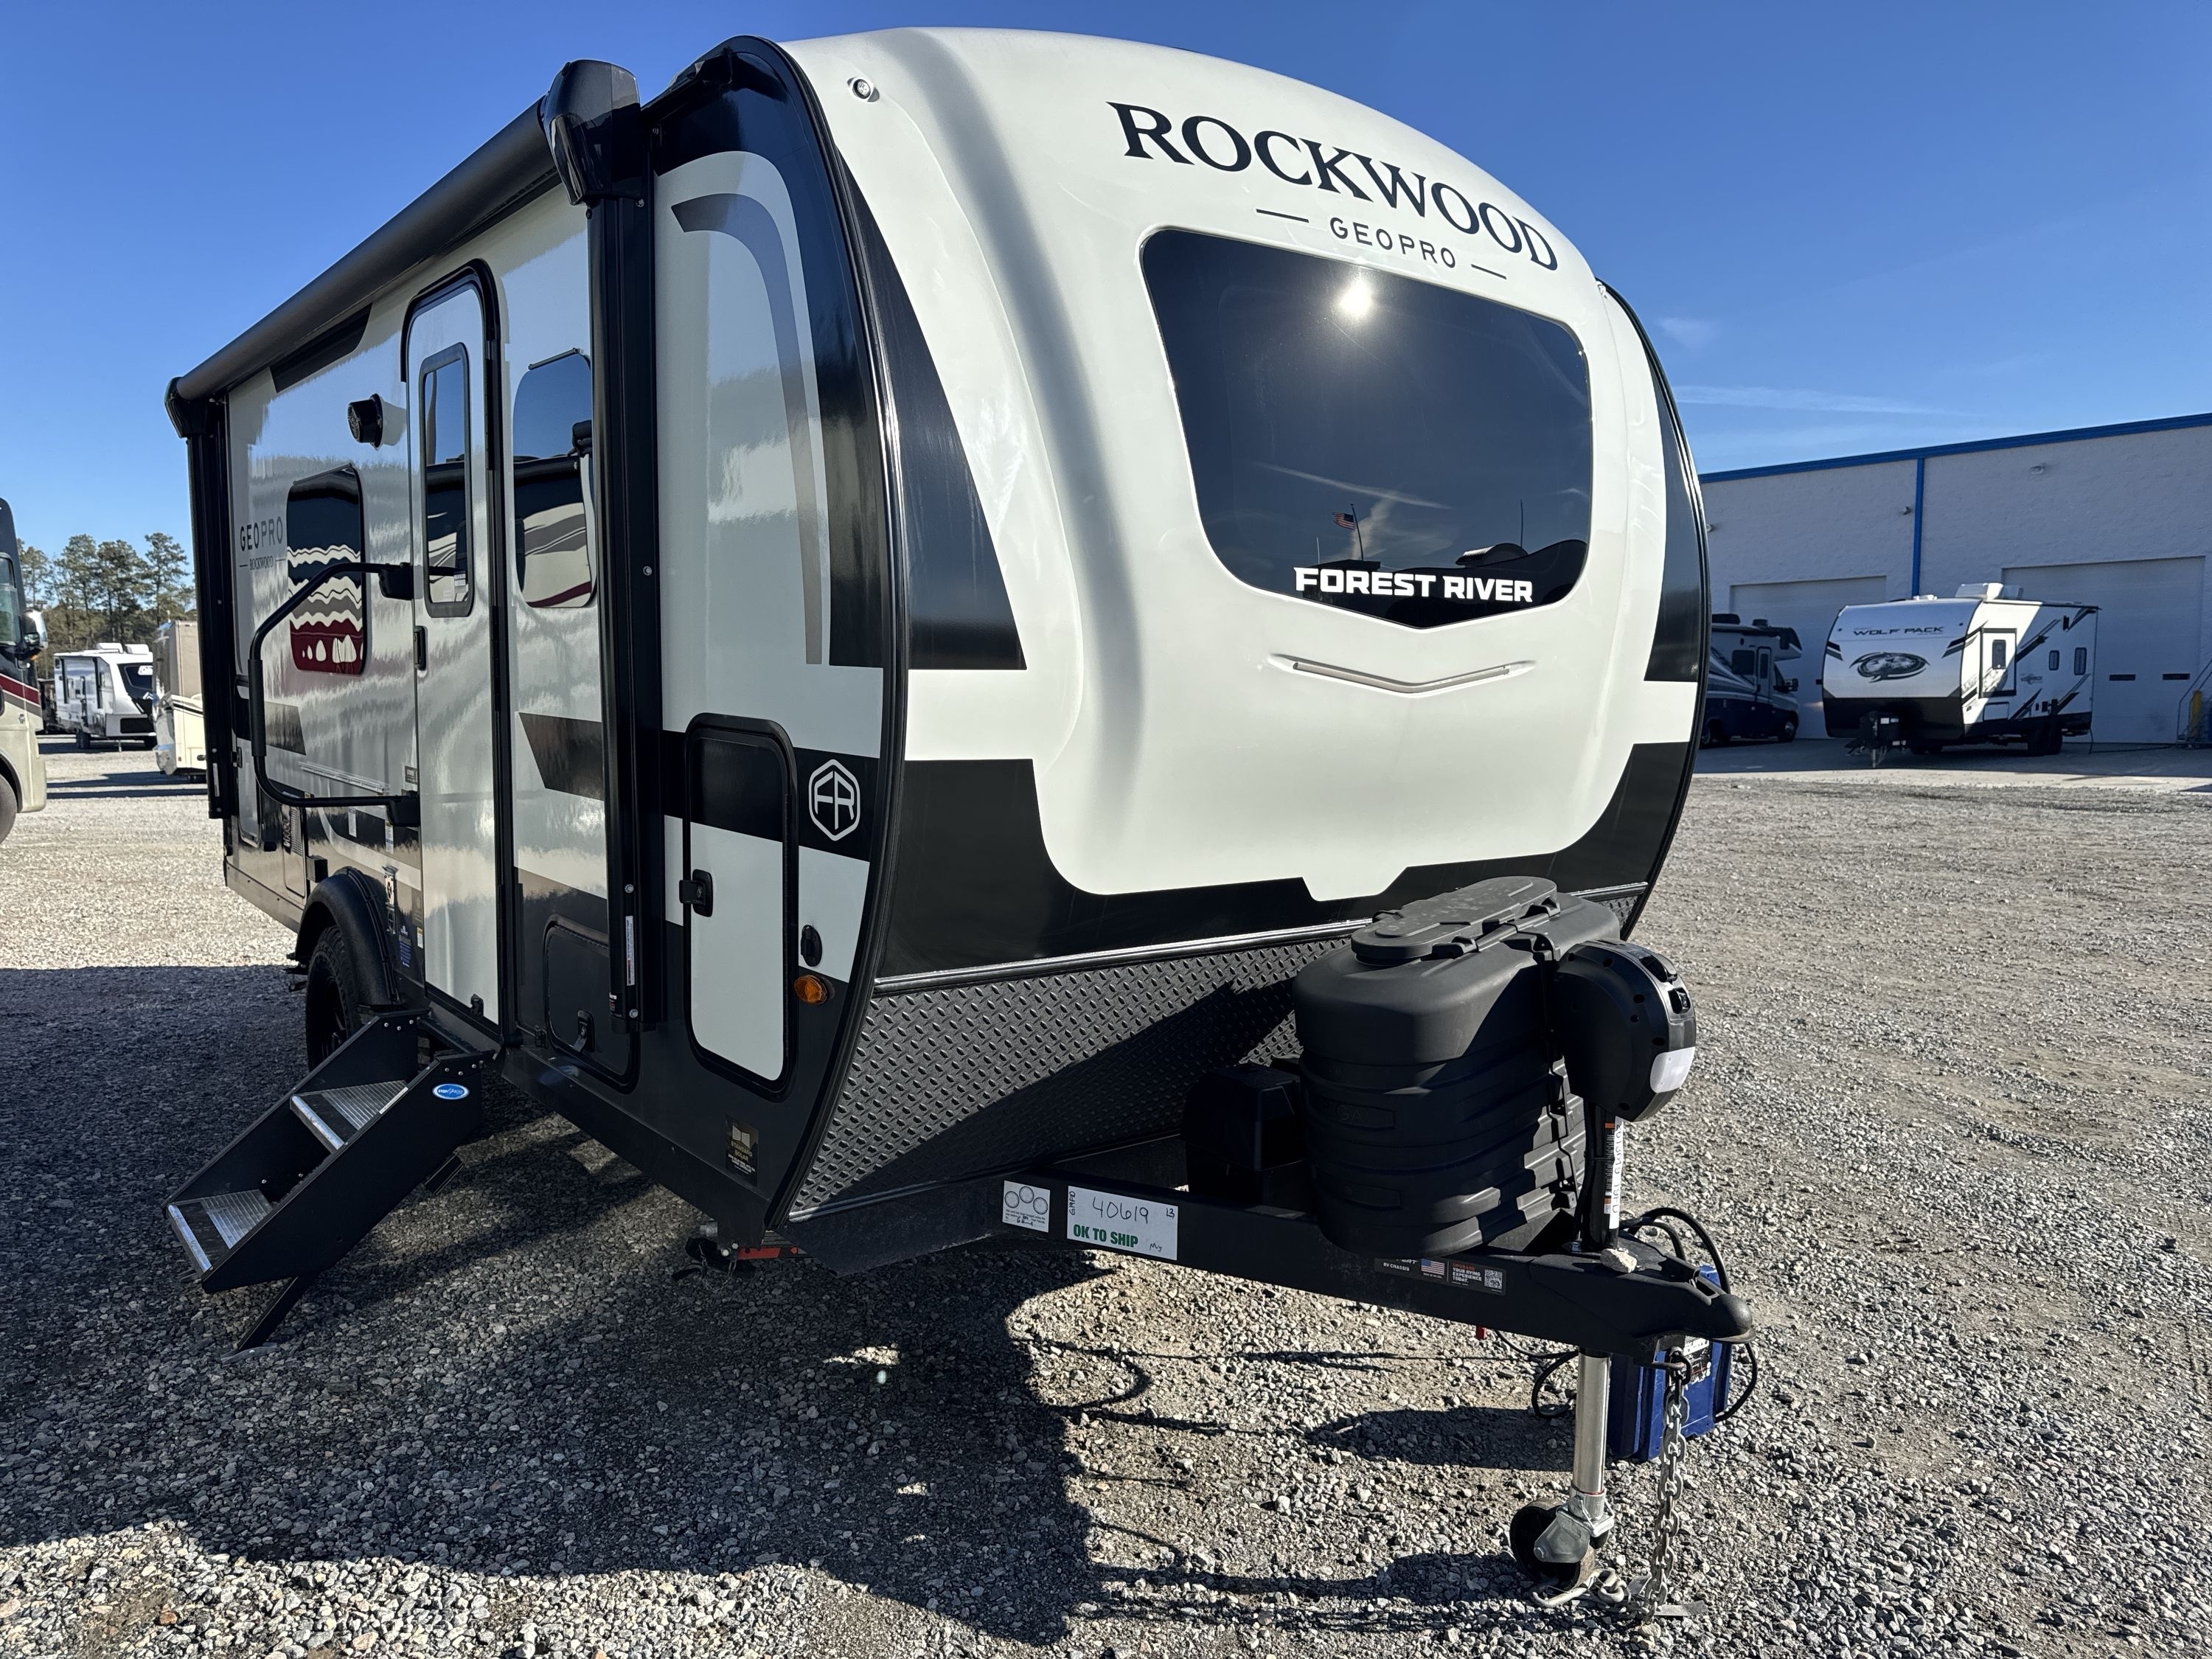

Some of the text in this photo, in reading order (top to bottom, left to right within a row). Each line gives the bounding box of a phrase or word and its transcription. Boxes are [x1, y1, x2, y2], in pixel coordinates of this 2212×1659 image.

[1105, 101, 1559, 271] ROCKWOOD
[1329, 217, 1456, 268] GEOPRO
[240, 516, 283, 552] GEOPRO
[249, 555, 274, 571] ROCKWOOD
[1293, 566, 1533, 602] FOREST RIVER
[1905, 626, 1944, 634] PACK
[1092, 1196, 1149, 1225] 40619
[1073, 1223, 1138, 1248] OK TO SHIP
[1390, 1263, 1410, 1272] CHASSIS
[1452, 1271, 1482, 1281] EXPERIENCE
